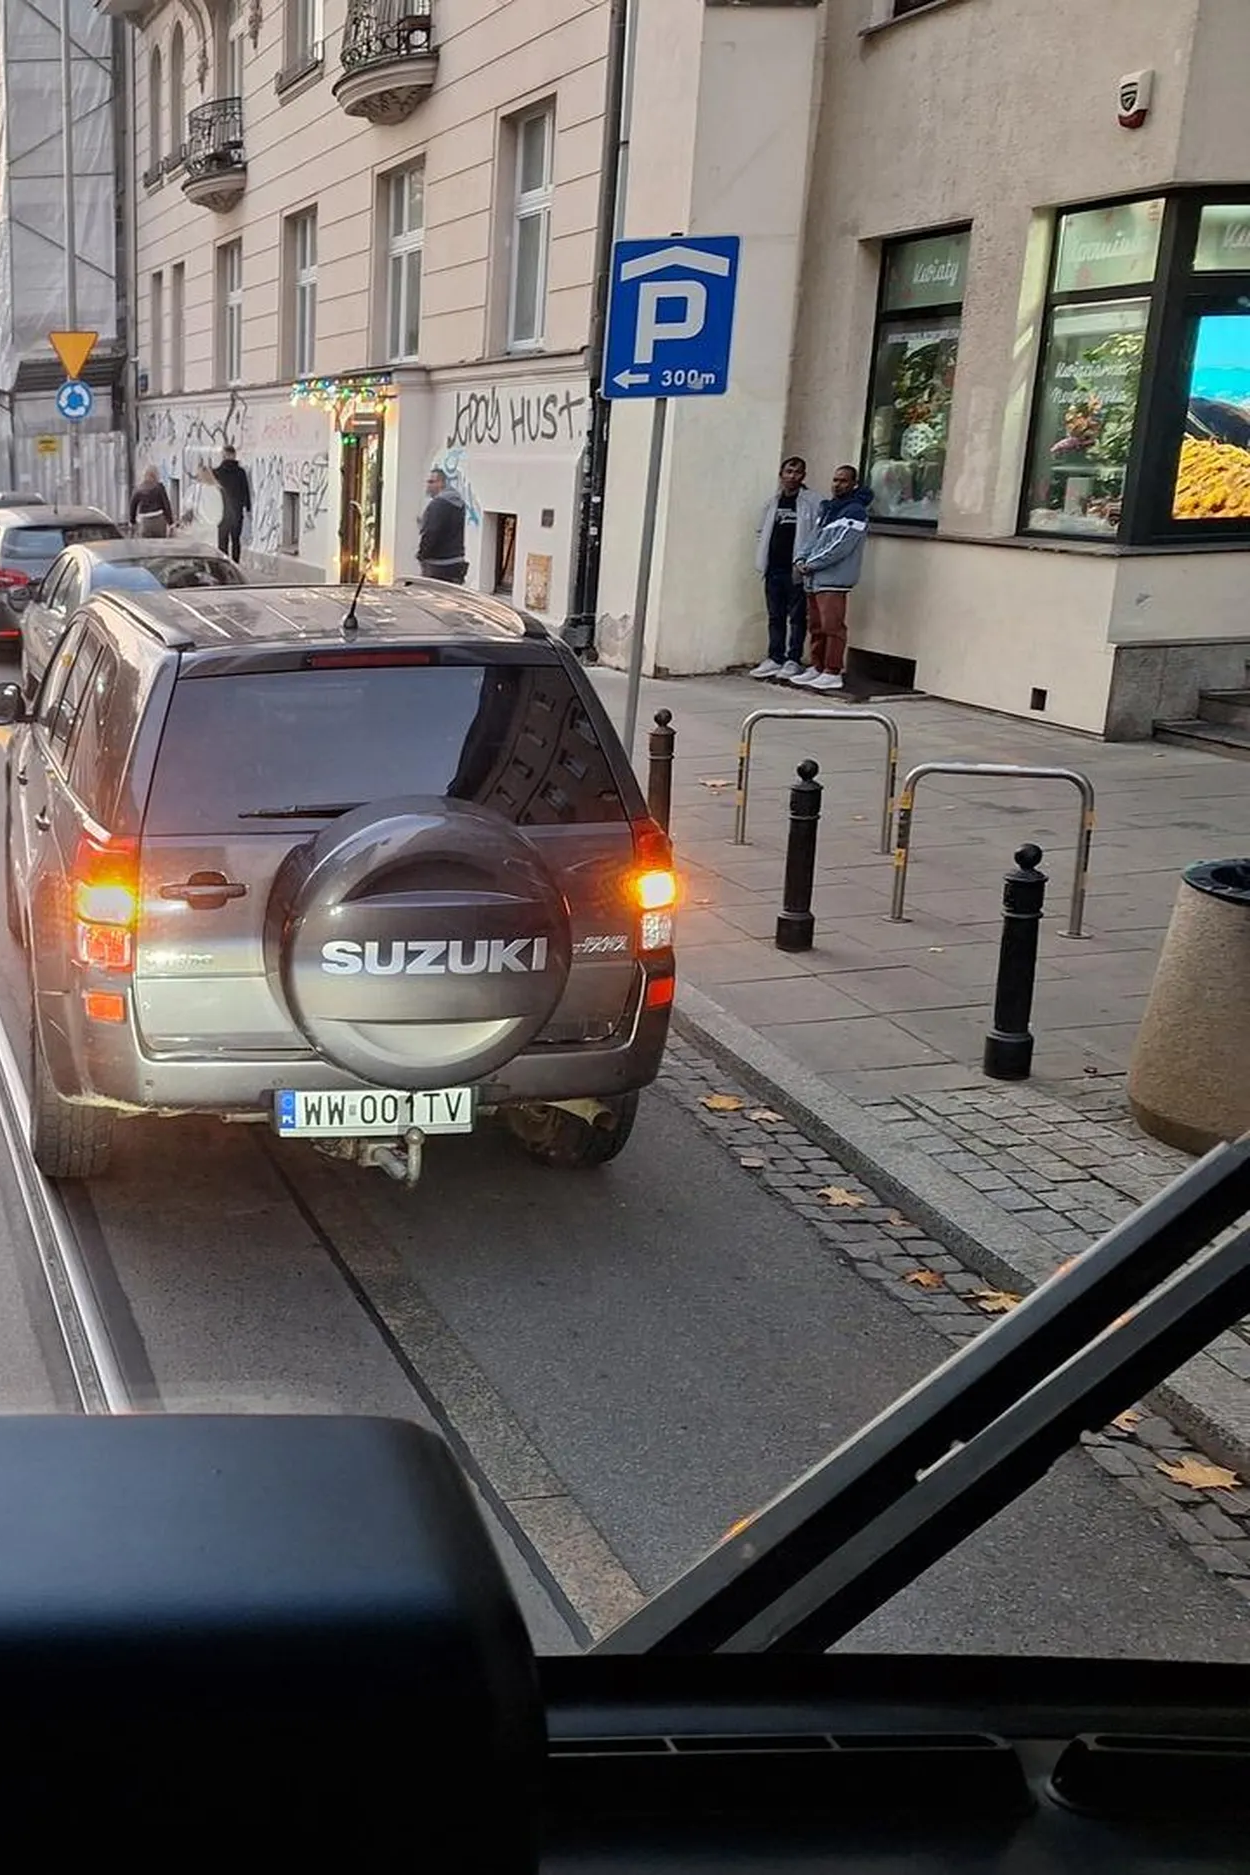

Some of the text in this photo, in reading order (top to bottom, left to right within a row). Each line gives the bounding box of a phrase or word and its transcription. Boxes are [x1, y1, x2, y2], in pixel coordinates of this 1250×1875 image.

[634, 280, 707, 364] P
[661, 369, 716, 387] 300m
[321, 937, 547, 975] SUZUKI
[304, 1096, 345, 1125] WW
[361, 1092, 462, 1124] 001TV
